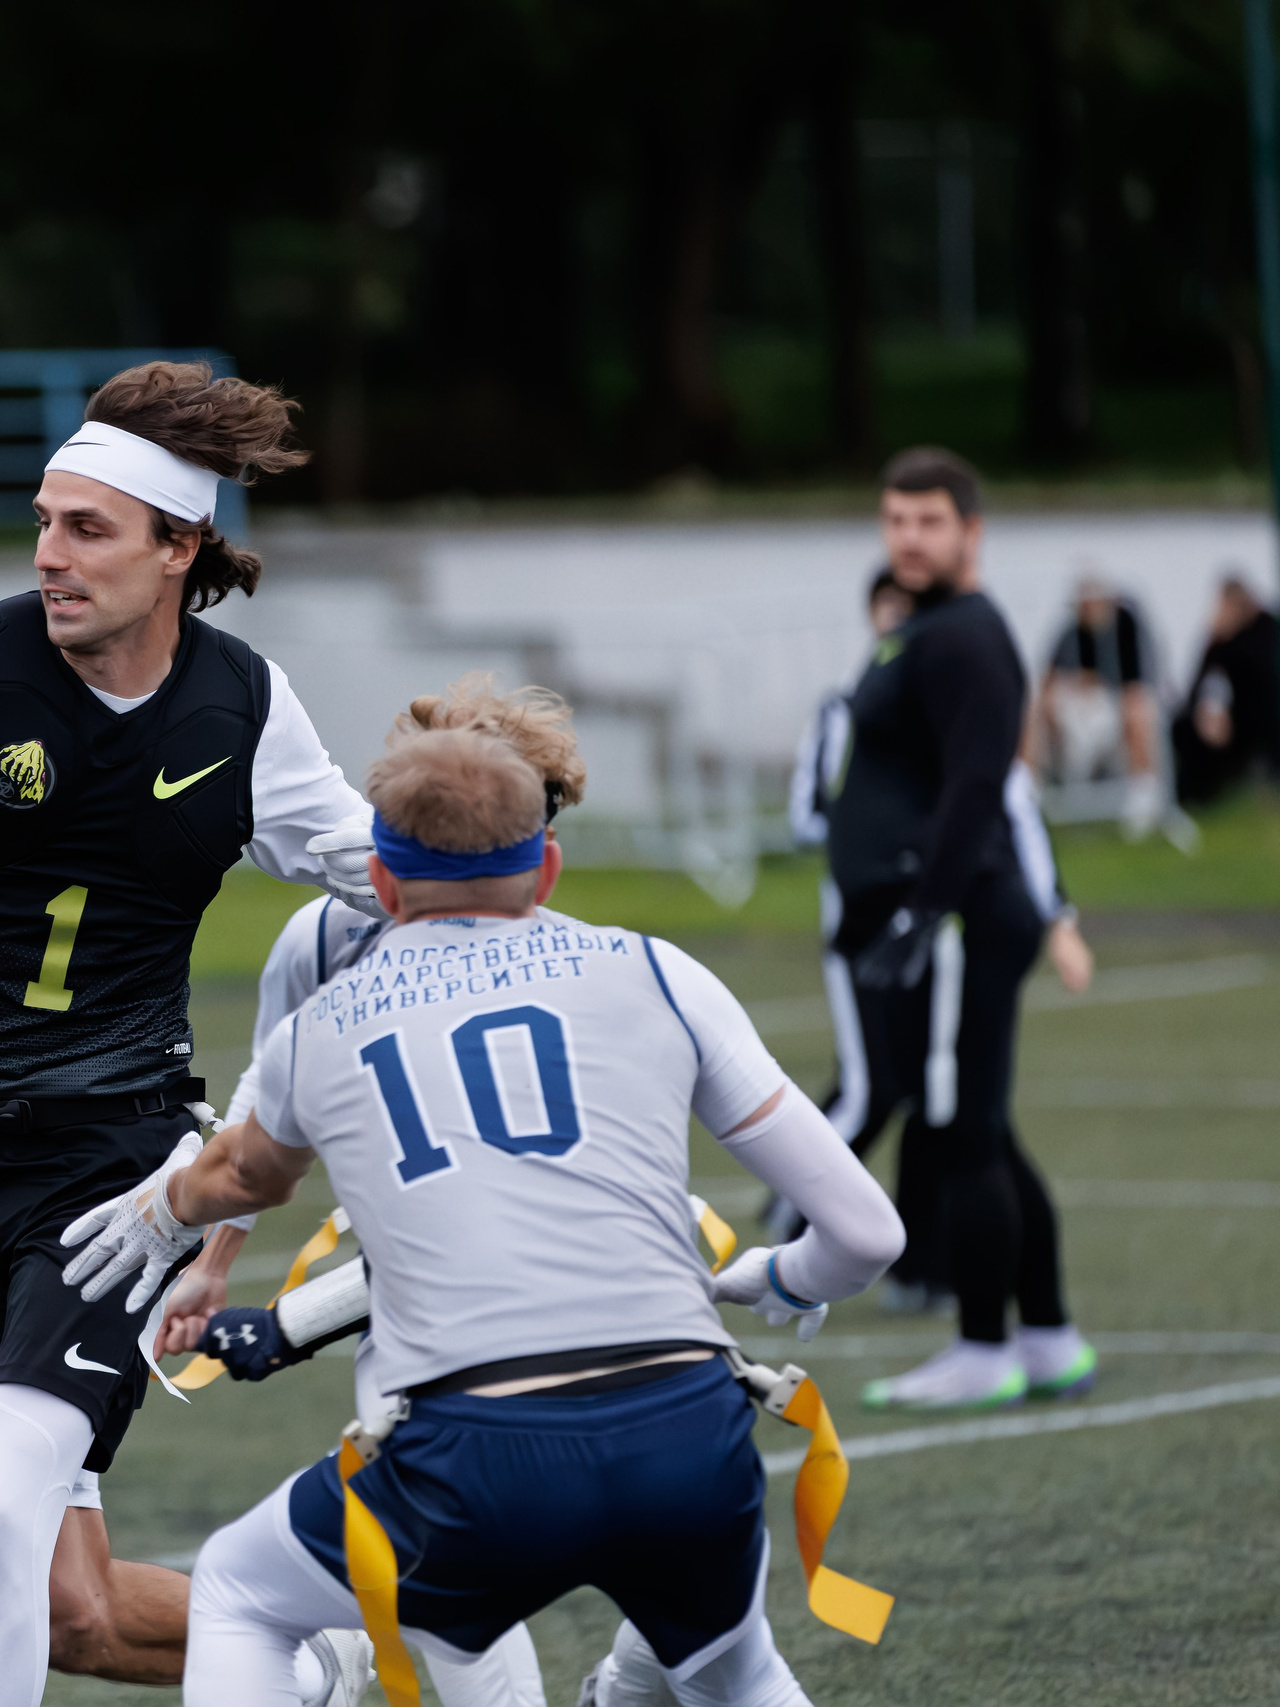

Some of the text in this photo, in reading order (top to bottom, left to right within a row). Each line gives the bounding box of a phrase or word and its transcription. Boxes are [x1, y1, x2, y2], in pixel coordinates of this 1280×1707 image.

[23, 885, 89, 1011] 1
[335, 956, 583, 1035] УНИВЕРСИТЕТ
[359, 1004, 583, 1184] 10
